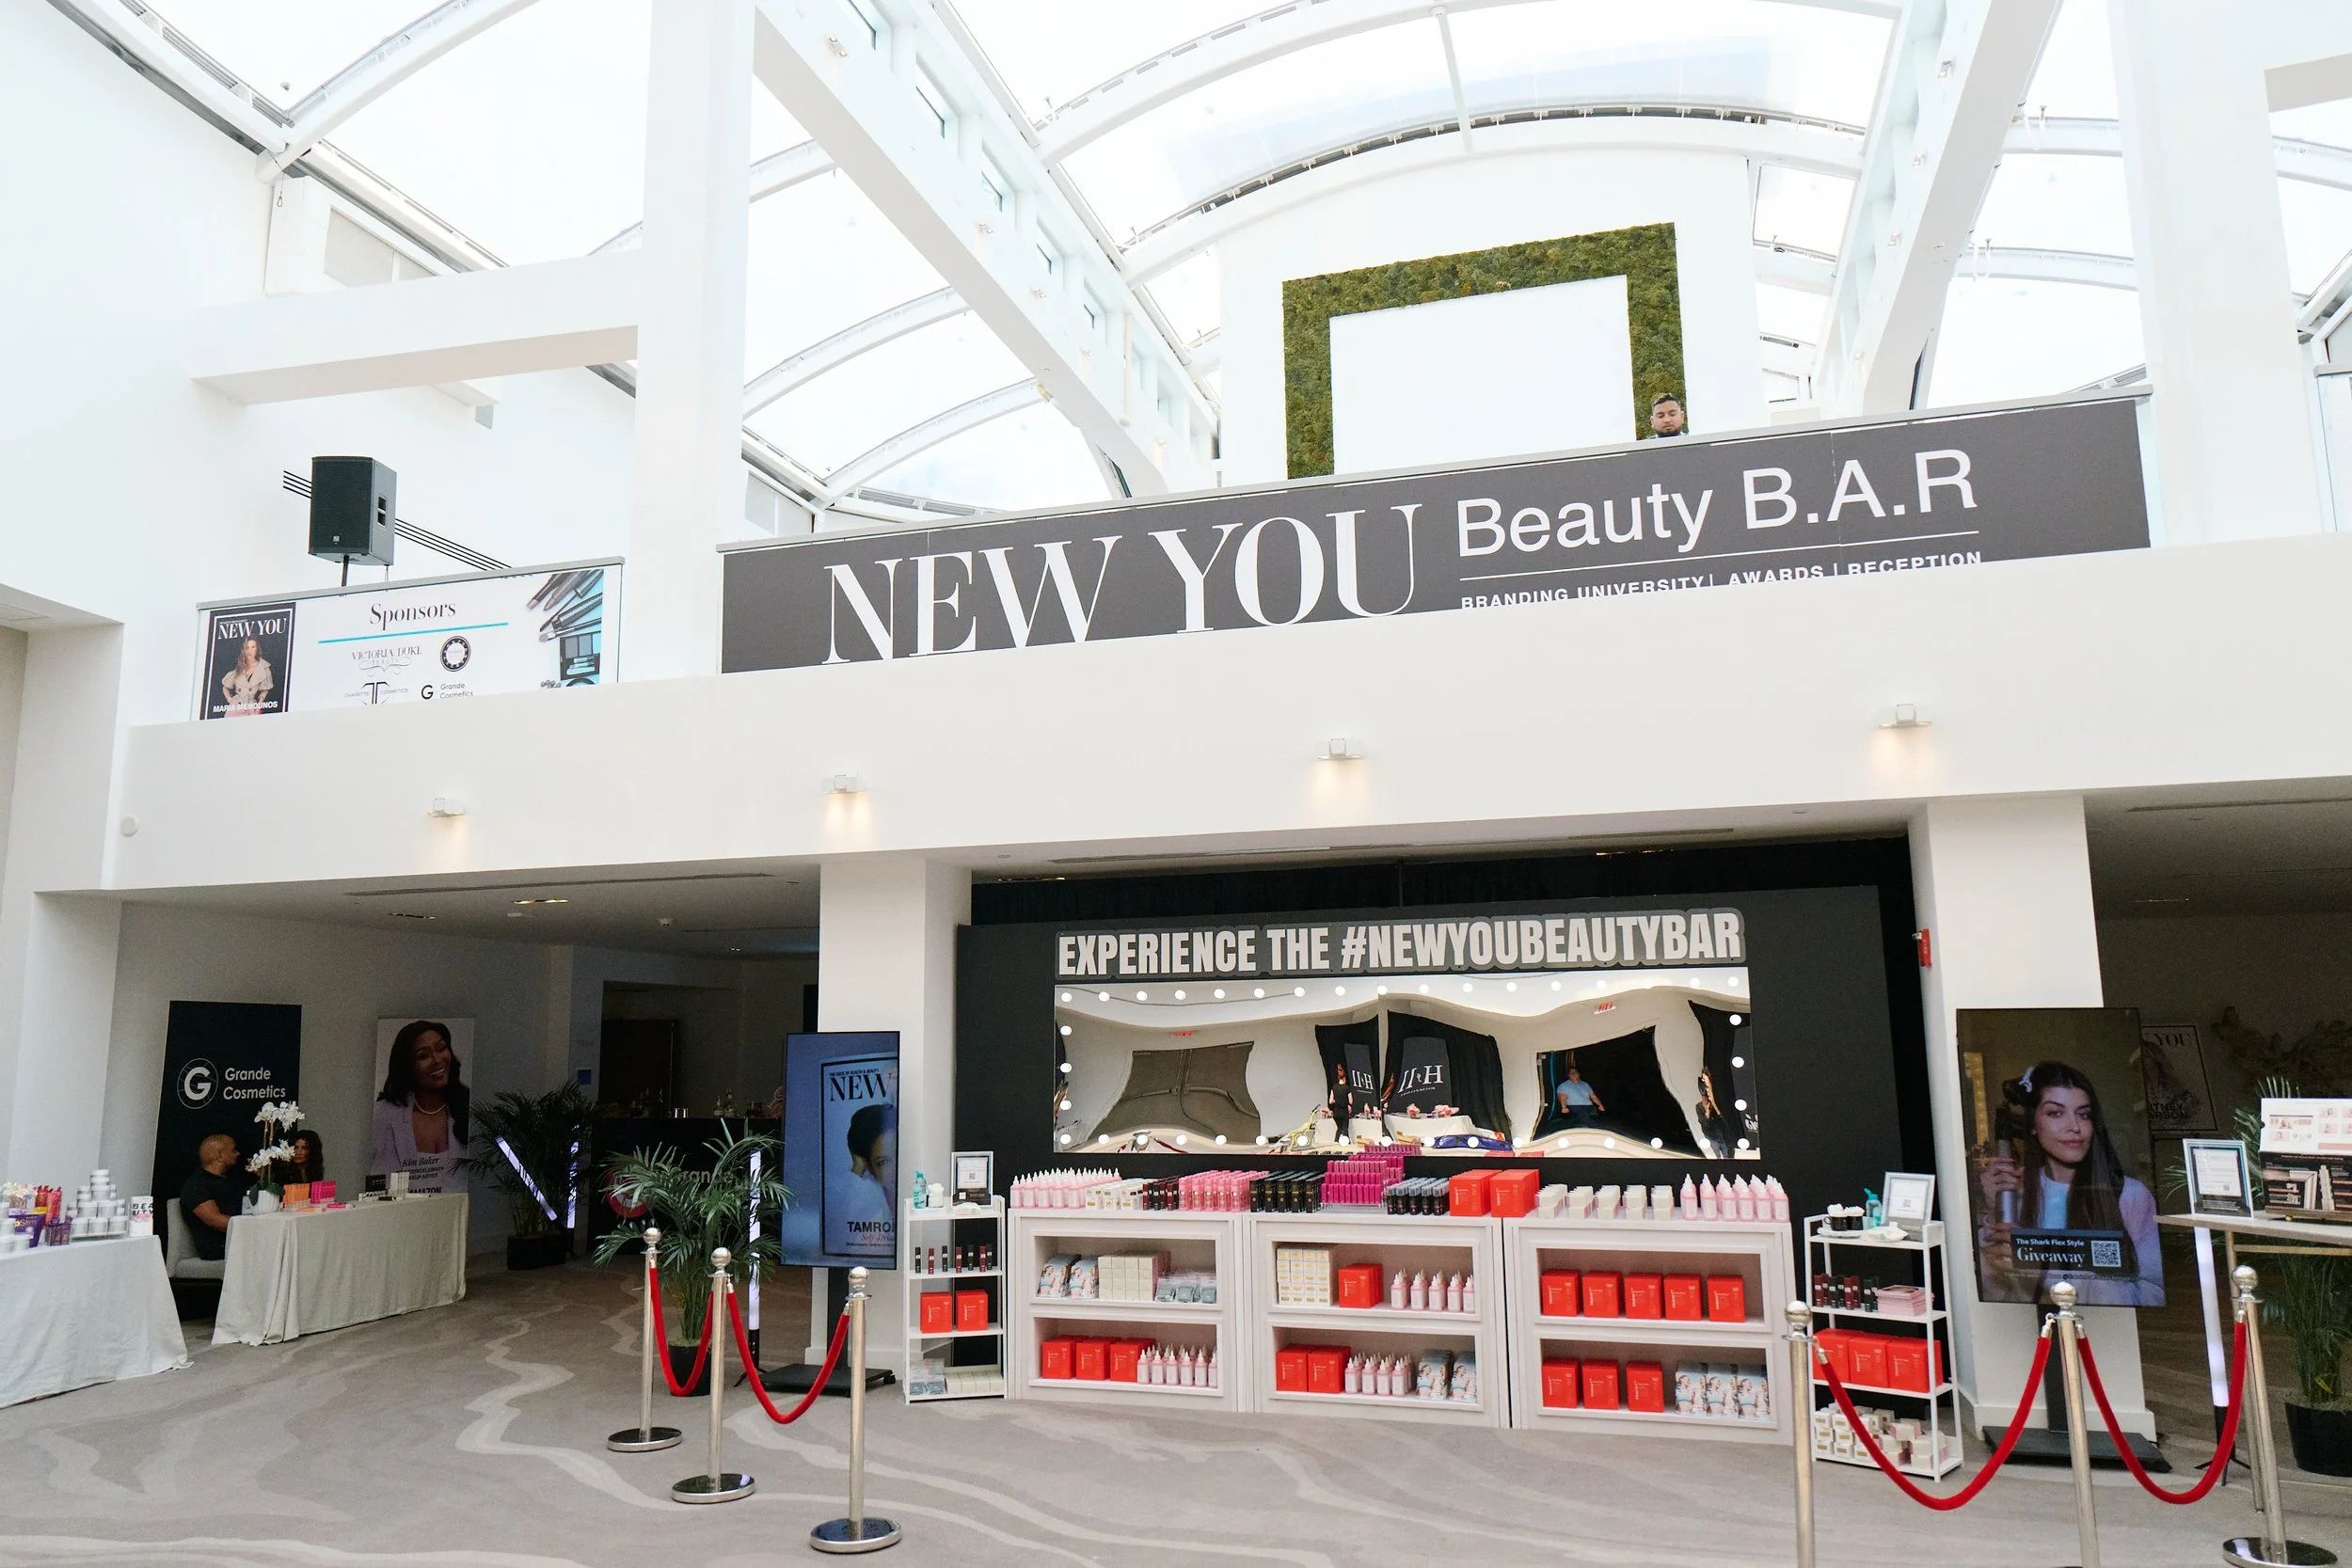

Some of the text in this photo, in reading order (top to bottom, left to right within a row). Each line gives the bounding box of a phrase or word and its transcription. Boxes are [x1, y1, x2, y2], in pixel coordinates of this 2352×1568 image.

[1456, 447, 1978, 557] Beauty B.A.R
[821, 503, 1422, 665] NEW YOU
[1461, 588, 1568, 610] BRANDING
[1728, 565, 1824, 585] AWARDS
[1848, 550, 1982, 577] RECEPTION
[370, 602, 456, 631] Sponsors
[218, 618, 287, 640] NEW YOU
[352, 645, 421, 660] VICTORIA DUKE
[439, 690, 474, 700] Cosmetics
[213, 700, 278, 713] MARIA MENOUNOS
[1058, 912, 1741, 975] EXPERIENCE THE #NEWYOUBEAUTYBAR
[224, 1067, 272, 1082] Grande
[223, 1085, 286, 1101] Cosmetics
[830, 1072, 892, 1101] NEW
[2016, 1246, 2086, 1268] Giveaway
